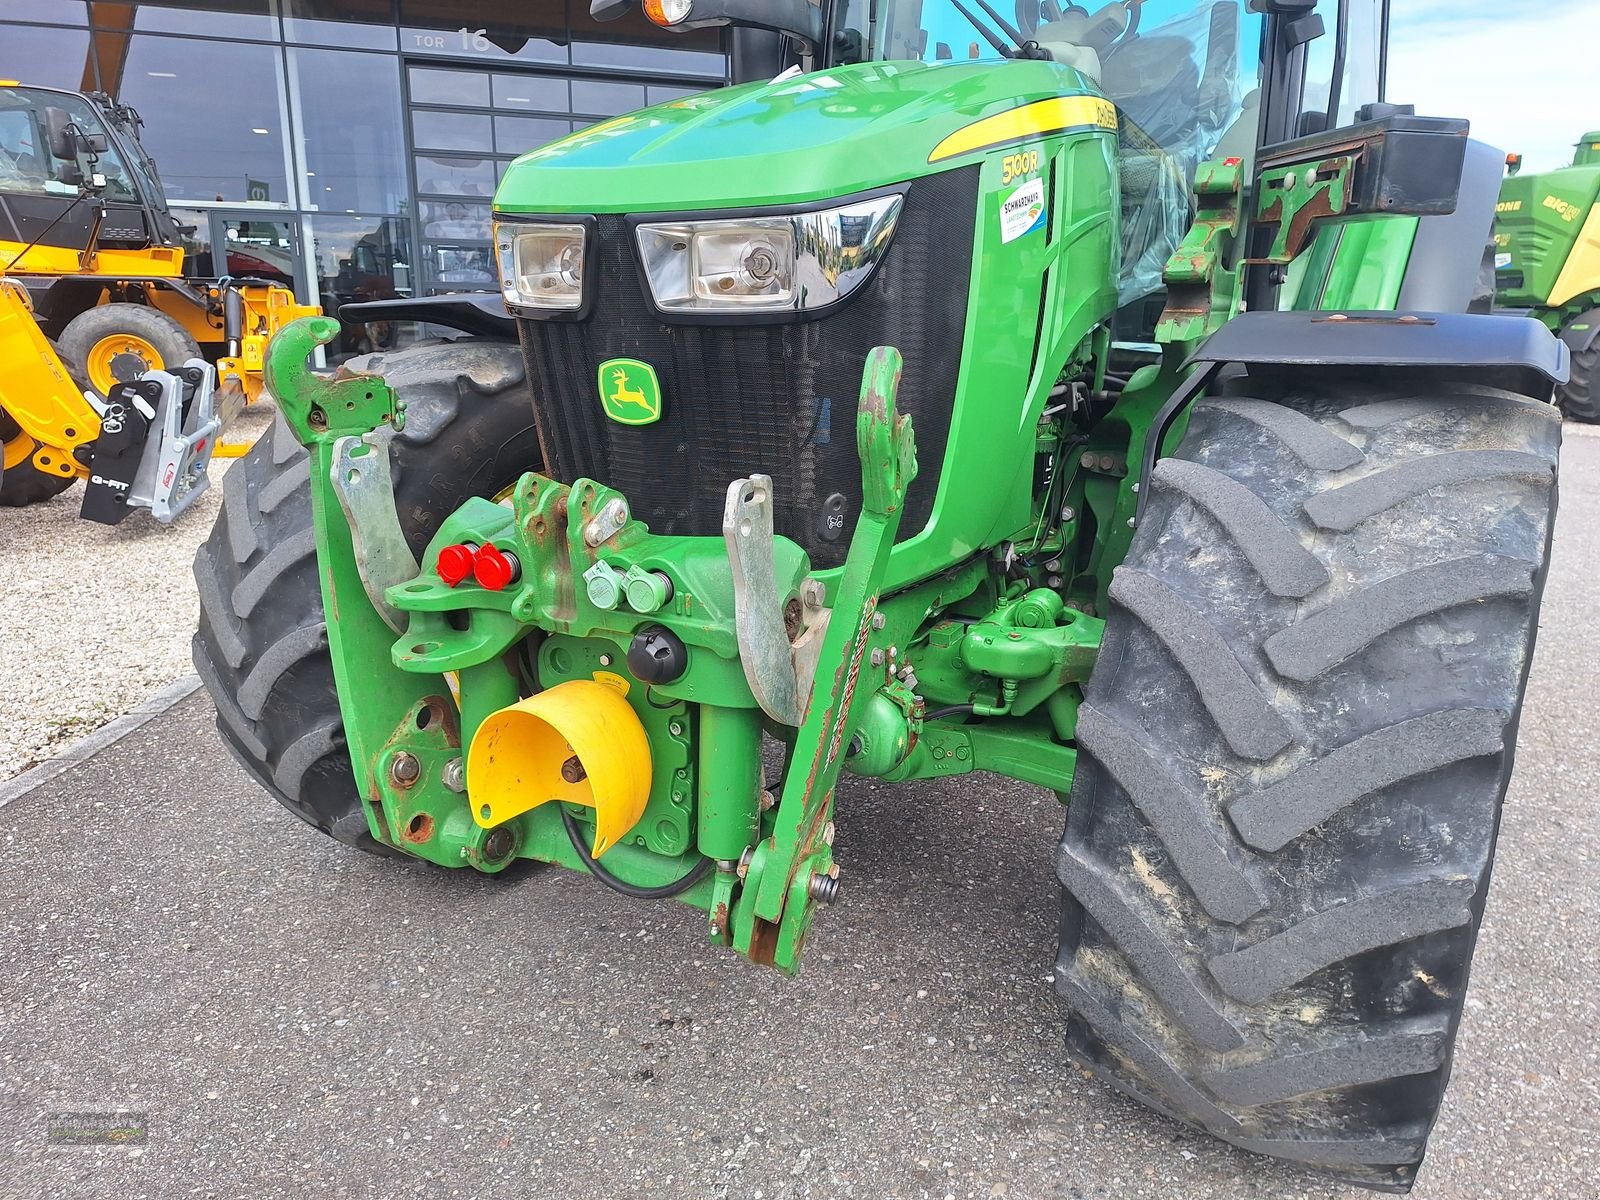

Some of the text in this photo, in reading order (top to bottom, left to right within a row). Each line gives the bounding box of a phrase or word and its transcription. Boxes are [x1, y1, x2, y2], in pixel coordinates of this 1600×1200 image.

[413, 27, 490, 52] TOR 16
[1004, 192, 1039, 214] SCHWARZMAYR
[1494, 200, 1522, 212] ONE
